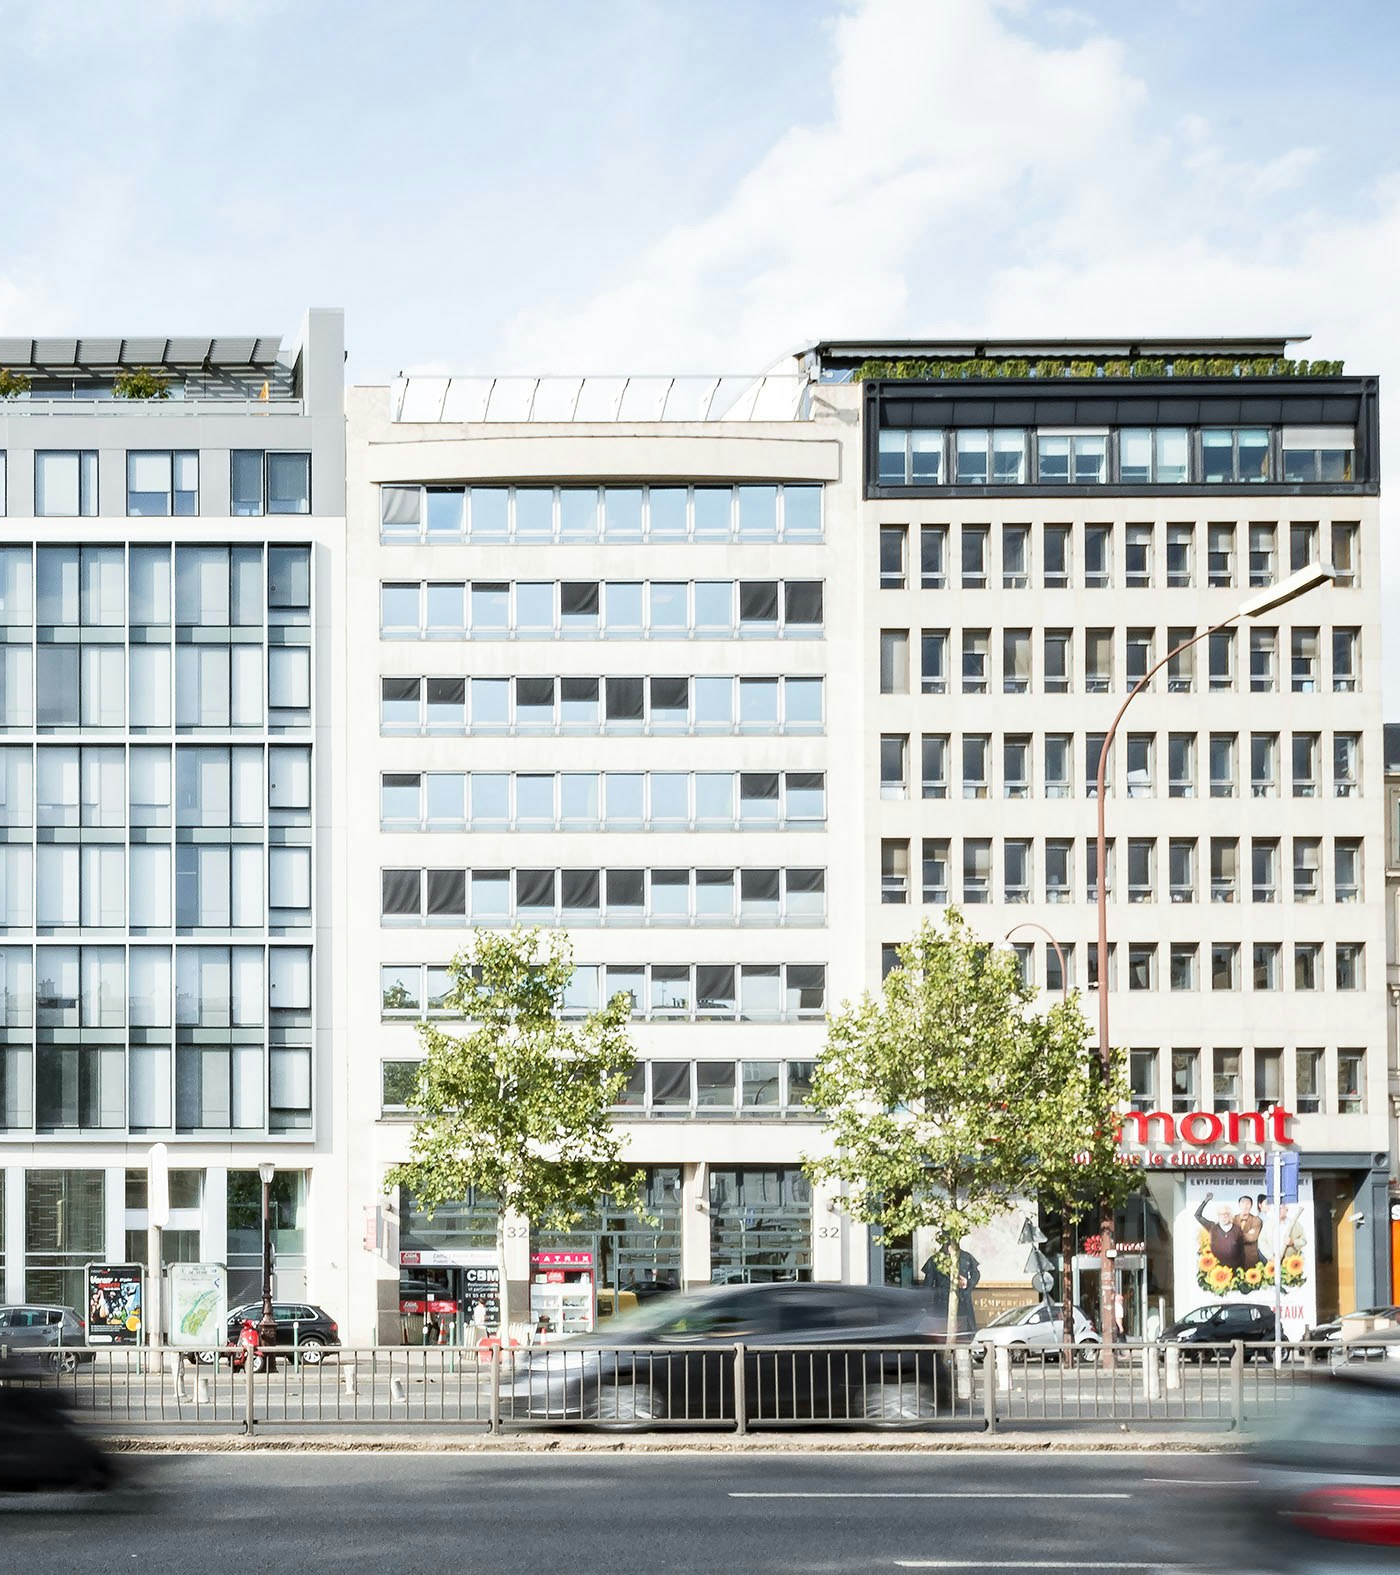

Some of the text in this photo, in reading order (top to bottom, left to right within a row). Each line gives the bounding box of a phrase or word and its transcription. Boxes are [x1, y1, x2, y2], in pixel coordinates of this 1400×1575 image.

[1112, 1106, 1294, 1145] mont
[1148, 1151, 1164, 1166] le
[1167, 1150, 1235, 1166] cinéma
[507, 1226, 528, 1239] 32
[818, 1226, 840, 1239] 32
[466, 1269, 499, 1282] CBM
